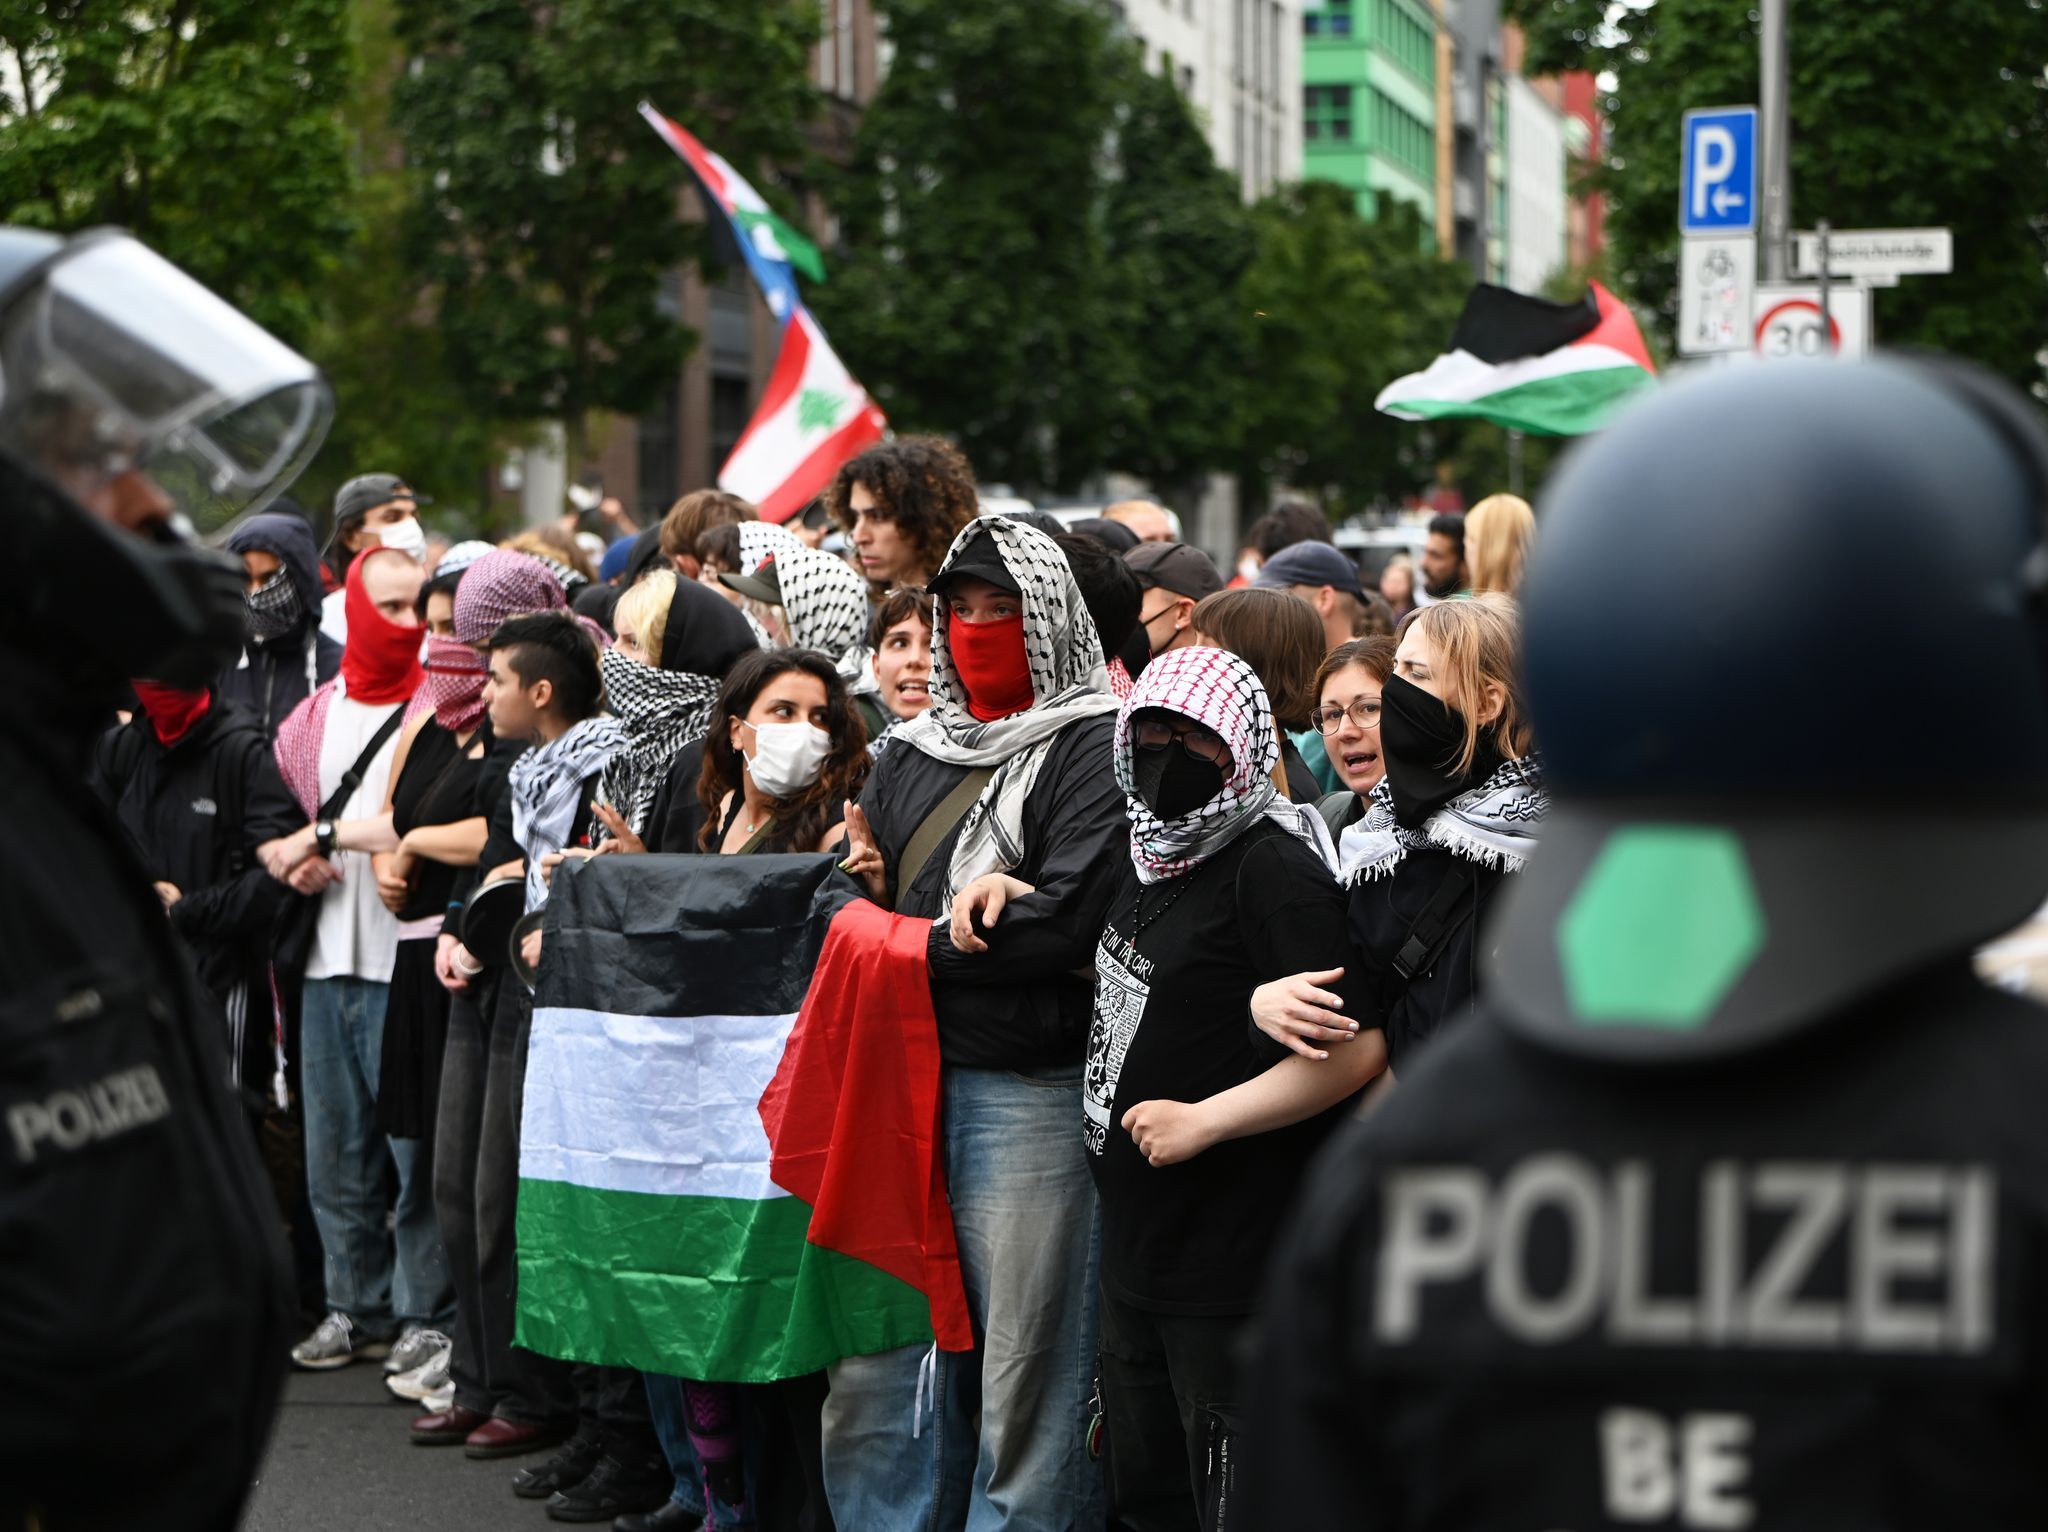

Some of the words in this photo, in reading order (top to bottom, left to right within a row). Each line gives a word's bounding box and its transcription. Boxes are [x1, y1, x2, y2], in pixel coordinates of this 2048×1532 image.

[1691, 125, 1738, 219] P
[1774, 325, 1828, 357] 30
[1131, 954, 1155, 982] CAR!
[1374, 1152, 1997, 1354] POLIZEI
[1601, 1407, 1755, 1530] BE
